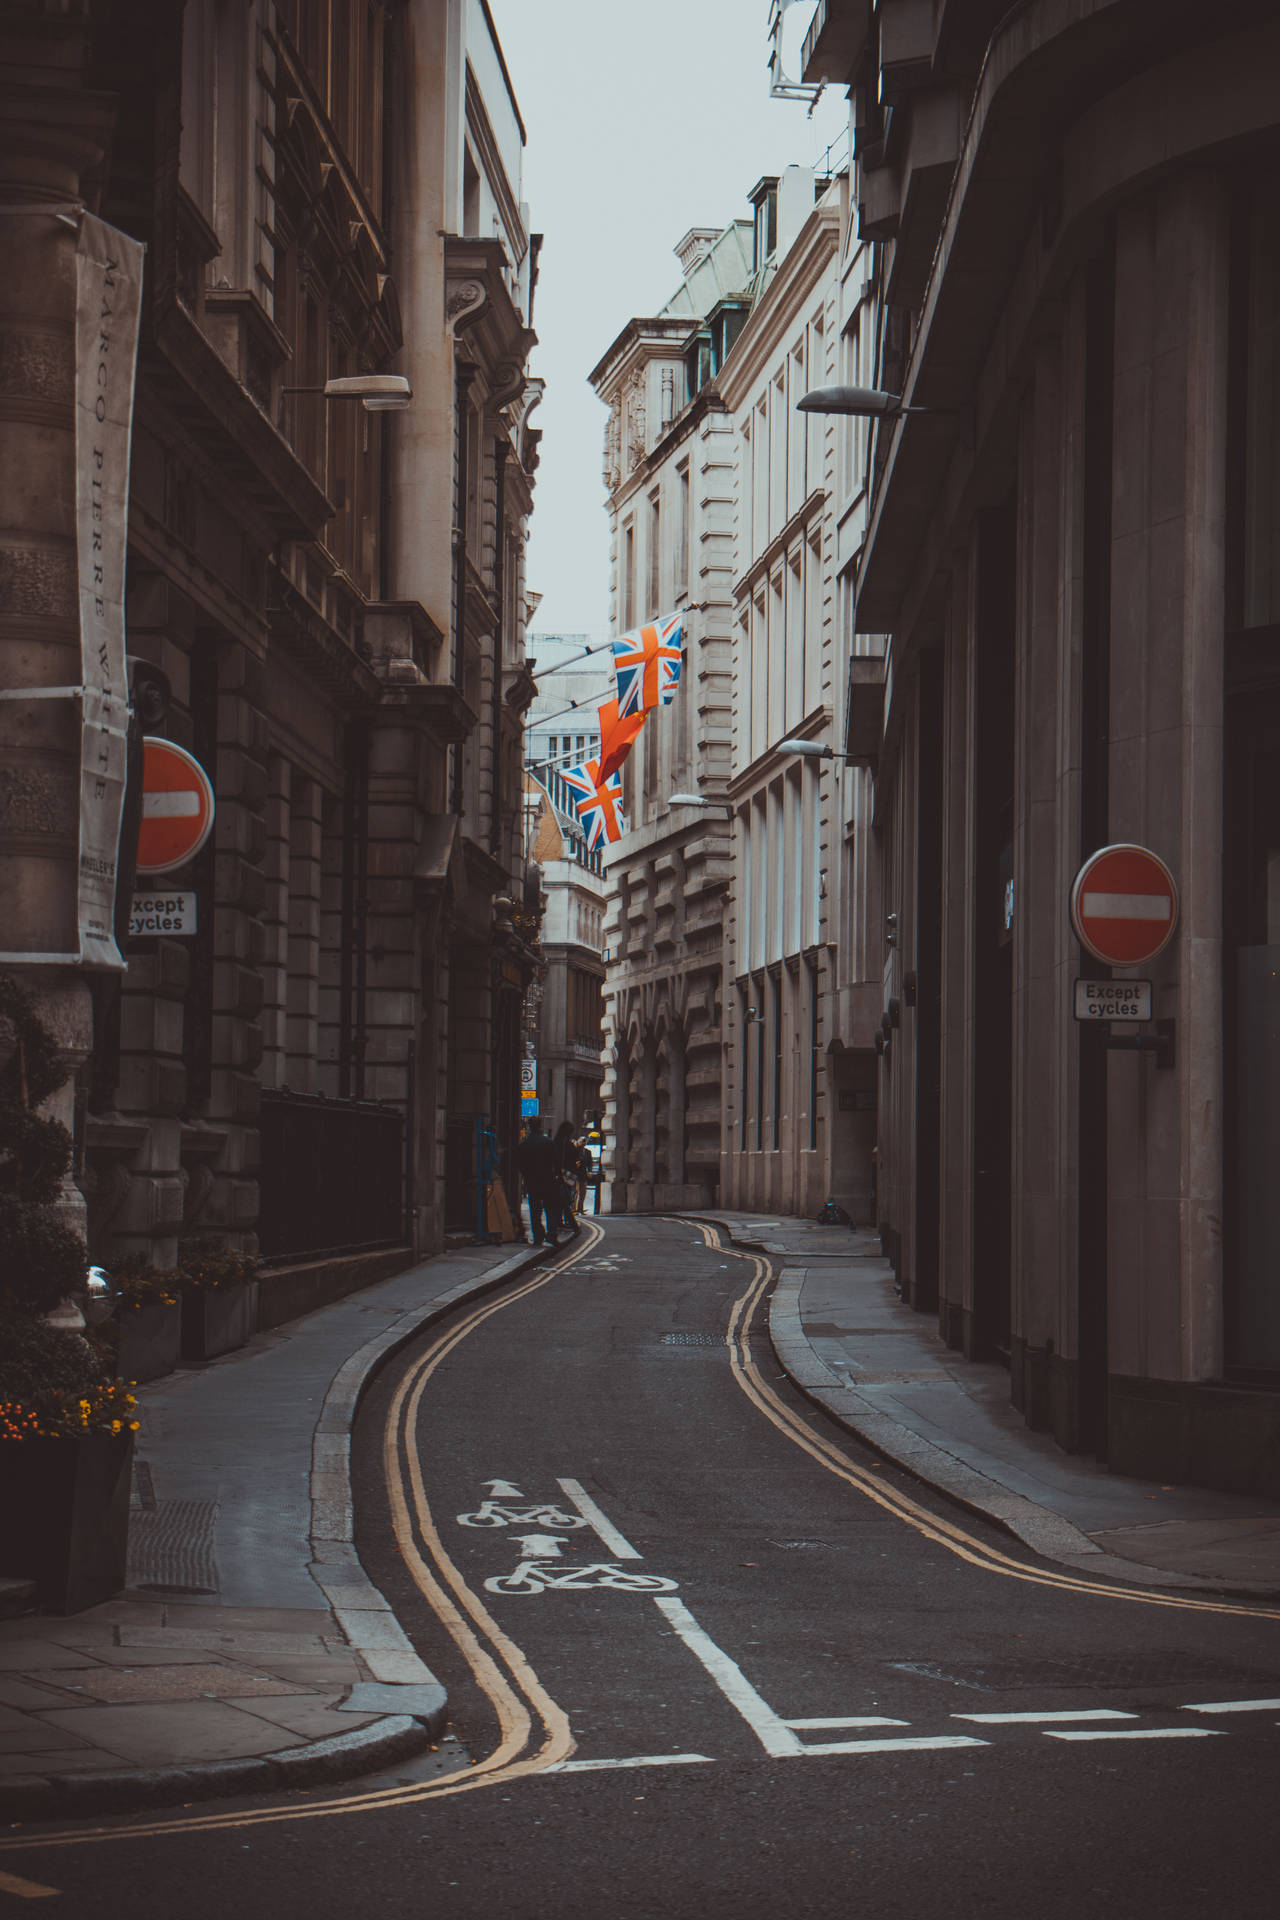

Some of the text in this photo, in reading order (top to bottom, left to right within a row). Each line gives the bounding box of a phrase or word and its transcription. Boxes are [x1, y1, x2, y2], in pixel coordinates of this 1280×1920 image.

[92, 256, 117, 800] MARCO PIERRE WHITE
[133, 896, 185, 915] xcept
[127, 914, 183, 933] cycles
[1087, 984, 1140, 1002] Except
[1088, 1001, 1138, 1016] cycles
